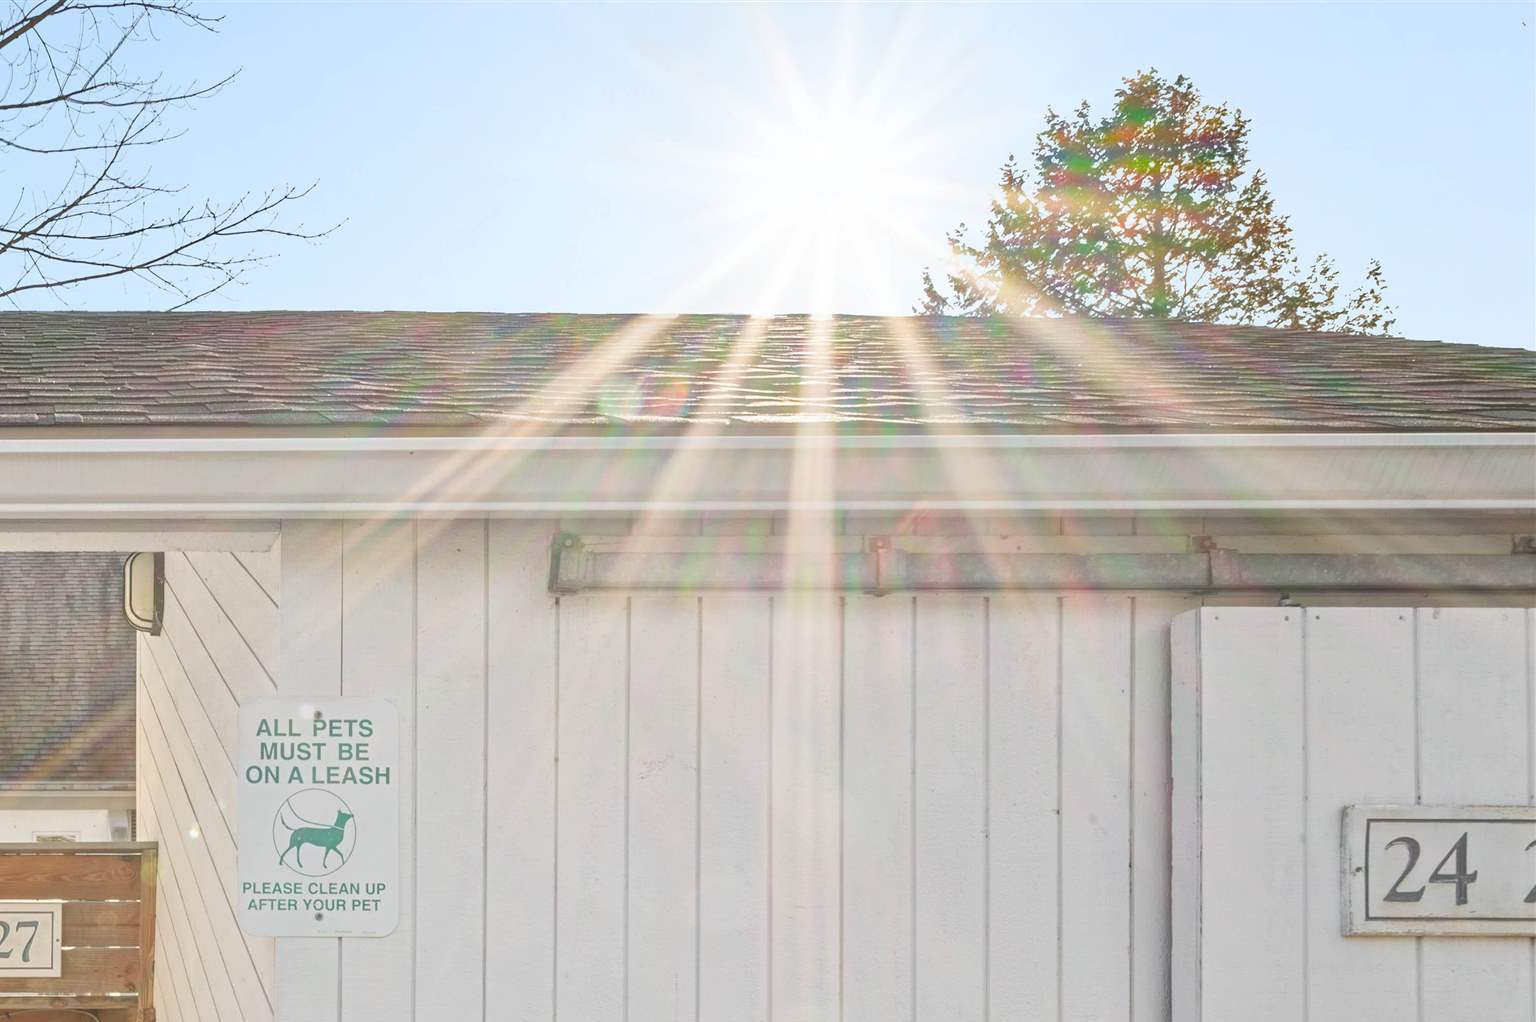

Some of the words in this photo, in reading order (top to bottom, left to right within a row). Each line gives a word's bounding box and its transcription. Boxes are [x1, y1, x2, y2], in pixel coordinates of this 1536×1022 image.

[256, 718, 301, 737] ALL
[313, 719, 373, 738] PETS
[260, 742, 326, 761] MUST
[338, 743, 370, 761] BE
[245, 765, 280, 784] ON
[287, 766, 304, 784] A
[312, 766, 391, 785] LEASH
[1382, 831, 1479, 907] 24
[242, 882, 303, 895] PLEASE
[308, 882, 360, 895] CLEAN
[366, 883, 386, 895] UP
[247, 899, 298, 911] AFTER
[302, 899, 346, 911] YOUR
[352, 900, 381, 912] PET
